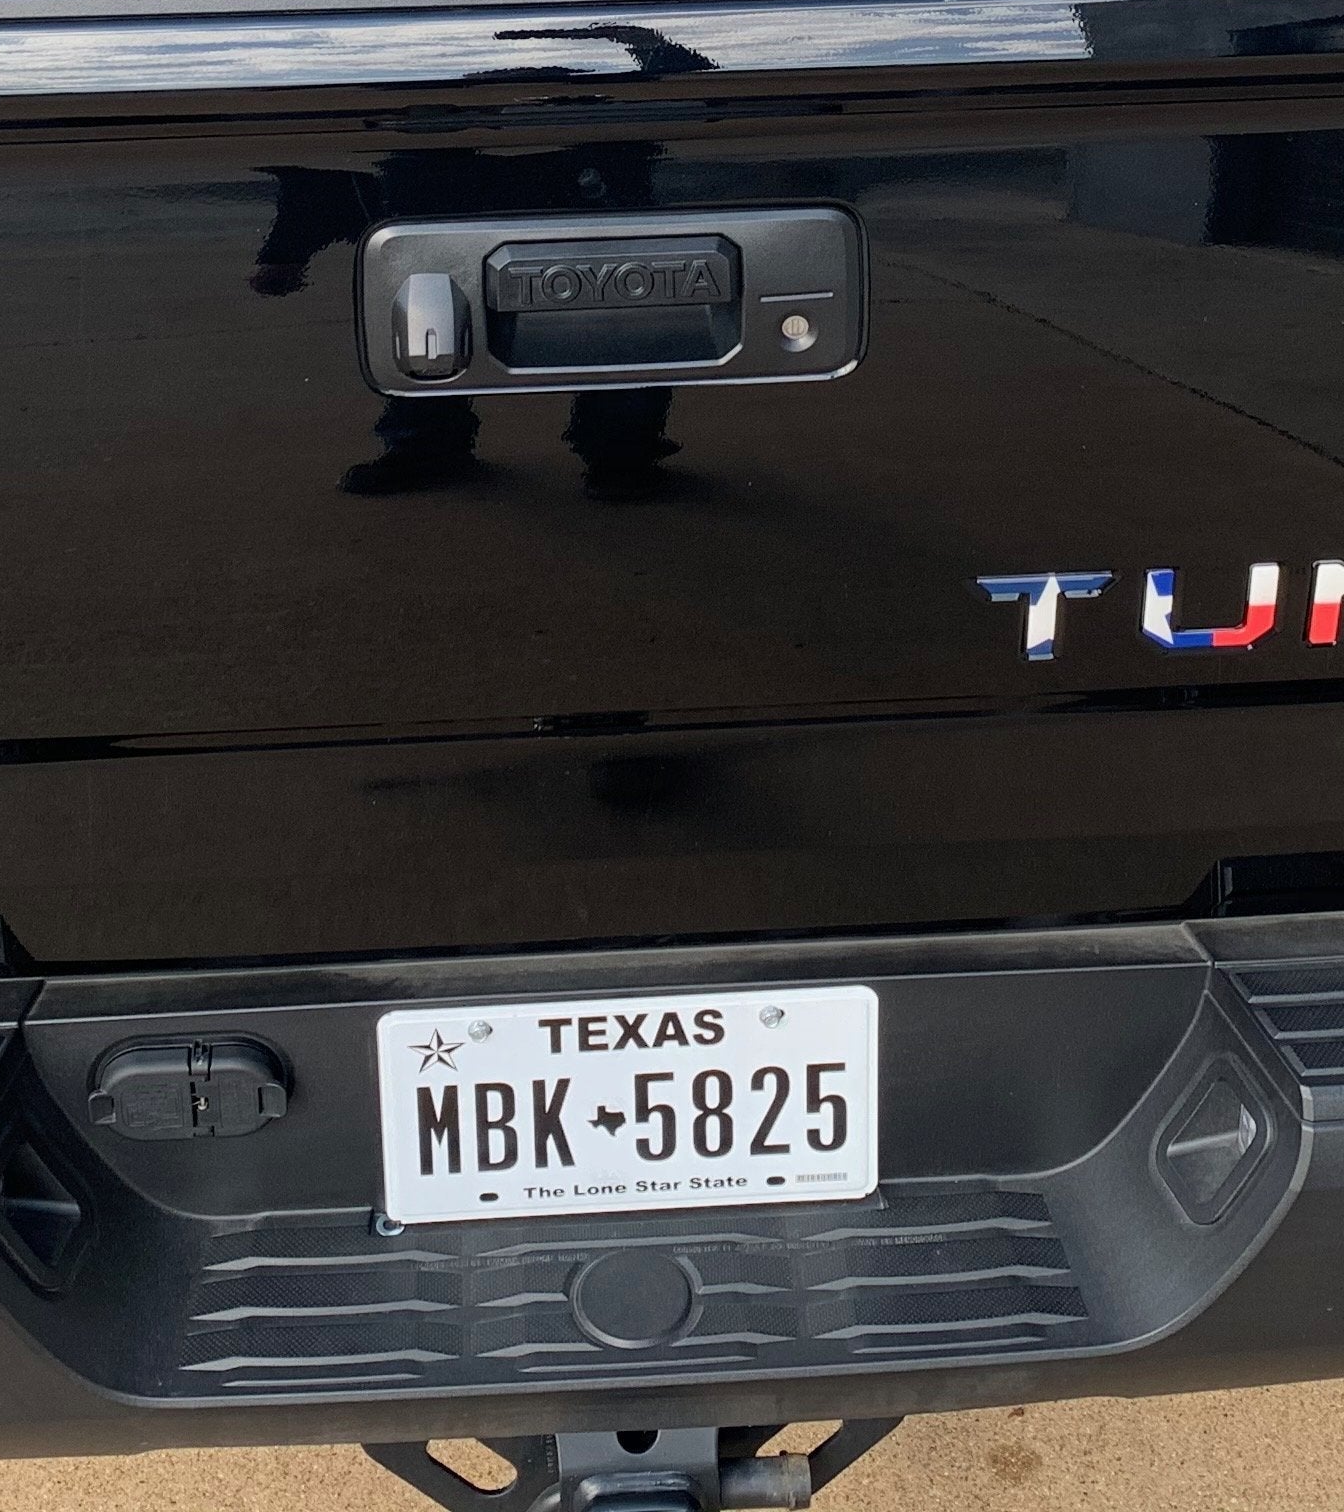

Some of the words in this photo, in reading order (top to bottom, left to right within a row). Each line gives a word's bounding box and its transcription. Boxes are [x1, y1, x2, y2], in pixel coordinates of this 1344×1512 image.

[508, 258, 722, 306] TOYOTA
[538, 1008, 726, 1054] TEXAS
[416, 1077, 575, 1176] MBK
[633, 1061, 849, 1162] 5825
[523, 1186, 567, 1200] The
[573, 1182, 627, 1196] Lone
[636, 1178, 683, 1194] Star
[689, 1174, 748, 1190] State
